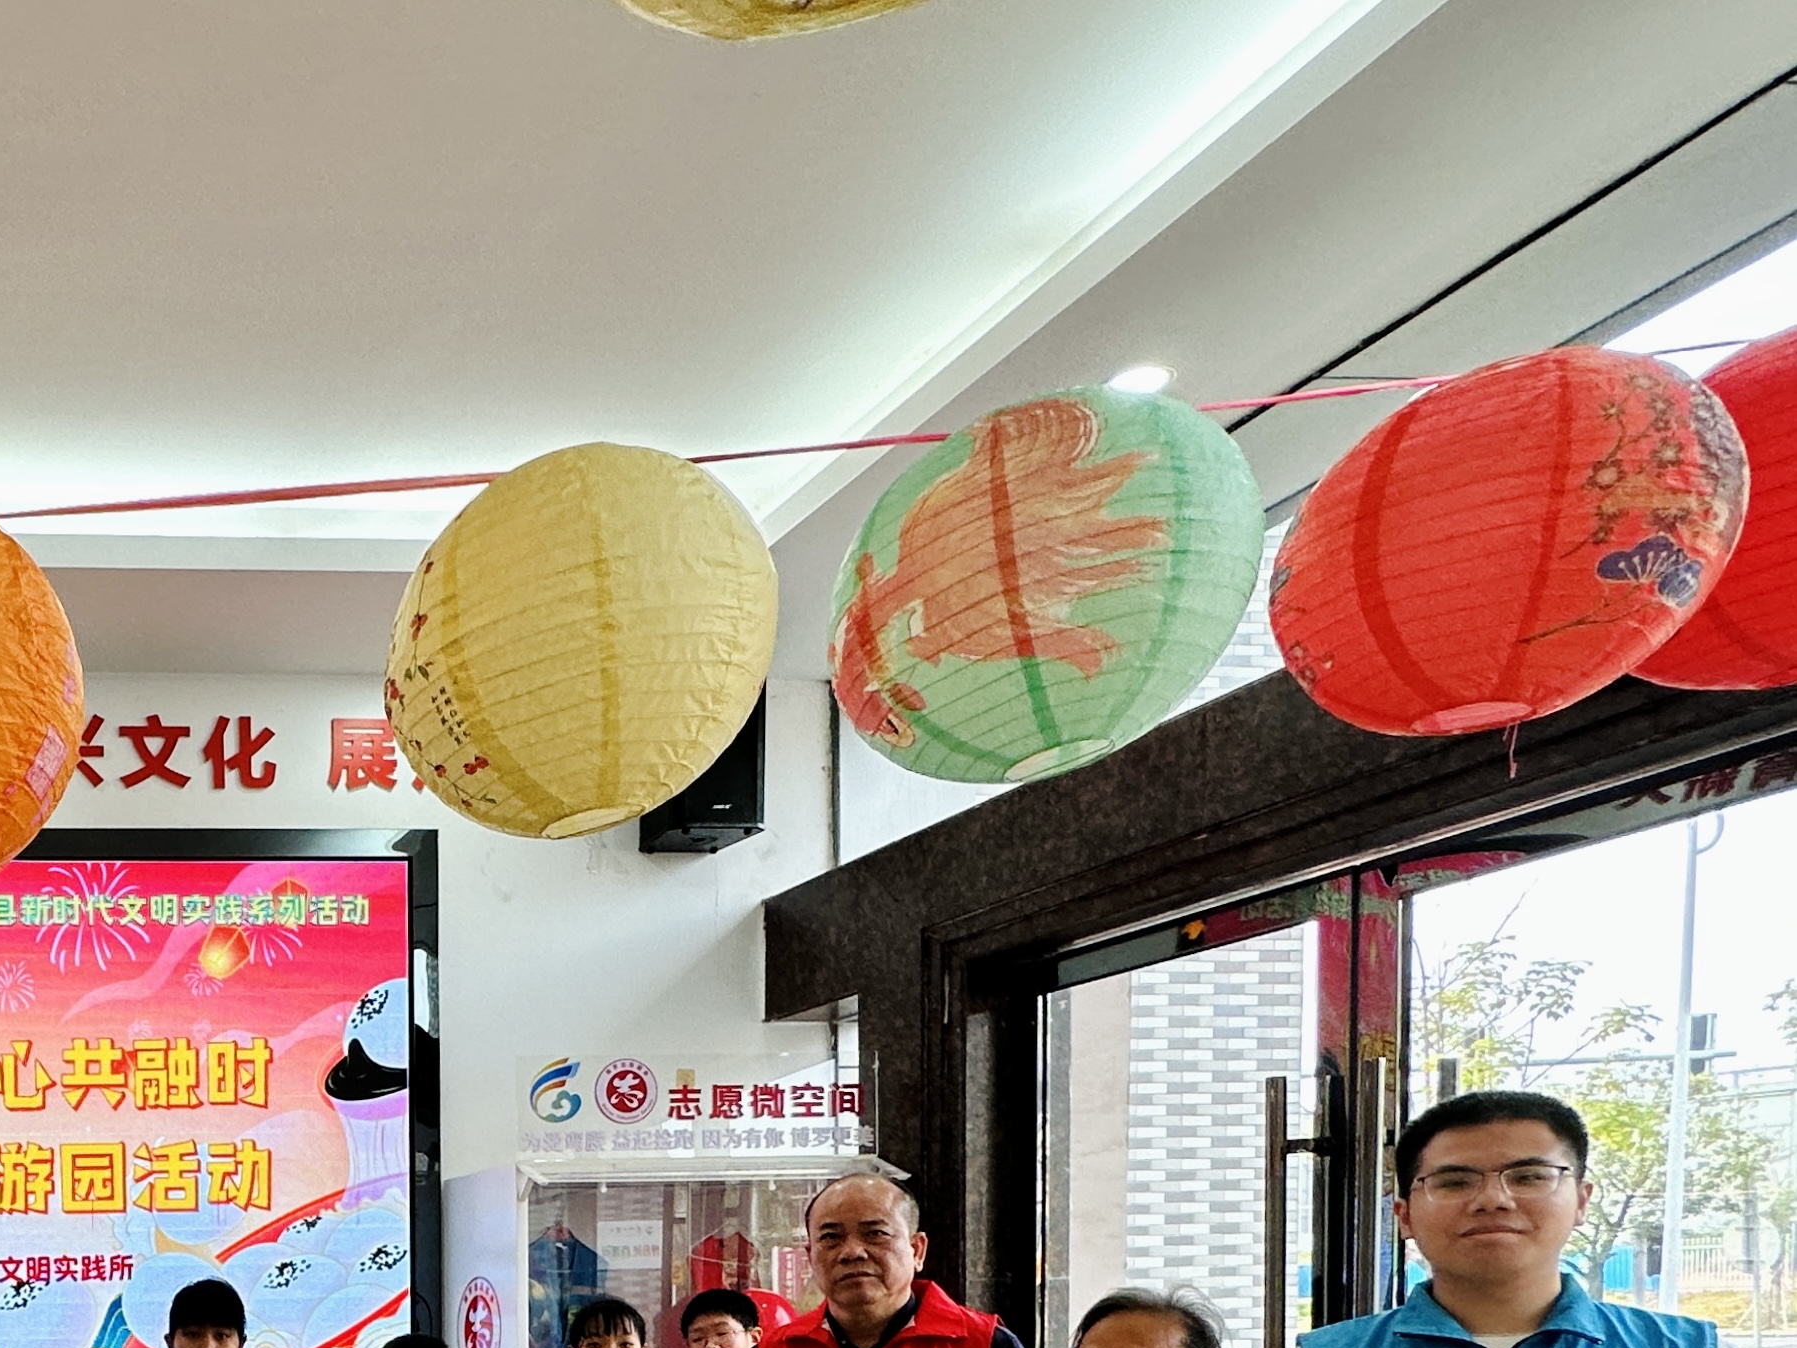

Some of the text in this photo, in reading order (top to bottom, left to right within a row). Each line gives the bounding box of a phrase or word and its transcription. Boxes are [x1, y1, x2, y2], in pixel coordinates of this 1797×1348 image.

[327, 717, 427, 792] 展
[668, 1082, 865, 1119] 志愿微空间
